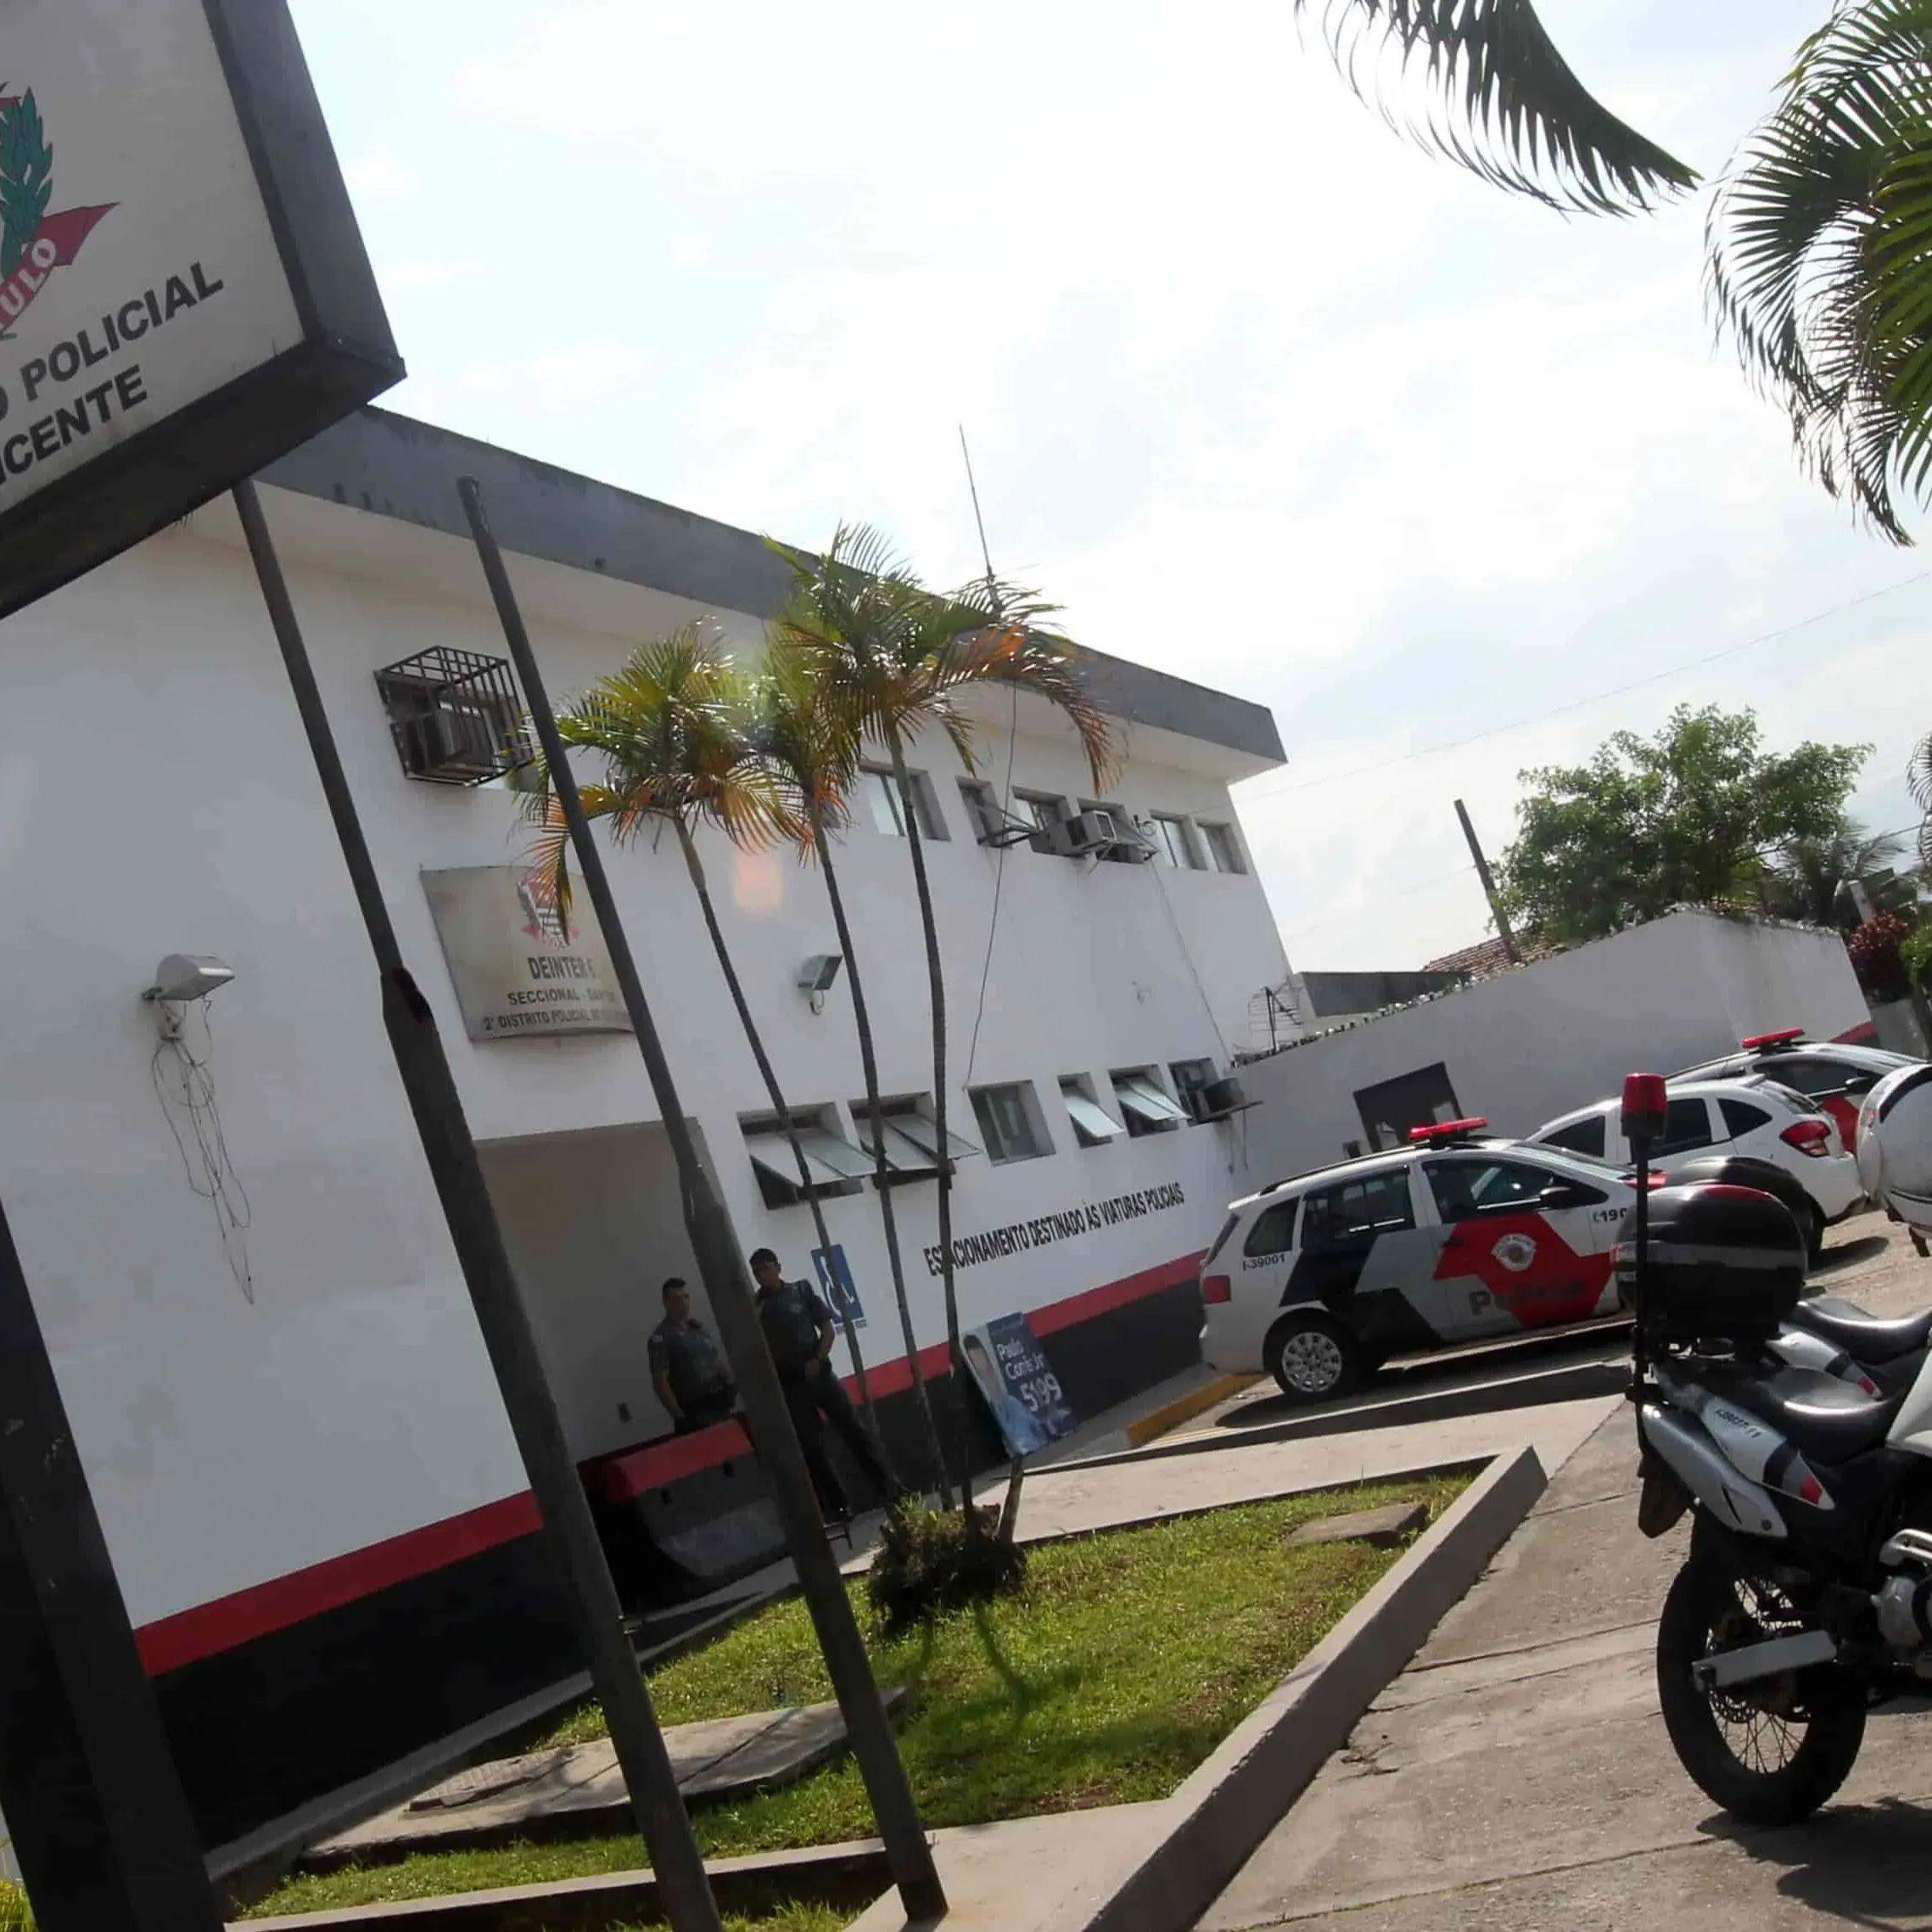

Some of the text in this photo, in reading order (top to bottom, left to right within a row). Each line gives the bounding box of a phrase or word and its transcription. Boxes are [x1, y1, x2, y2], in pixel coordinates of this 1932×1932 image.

[20, 263, 223, 402] POLICIAL
[507, 988, 581, 1005] SECCIONAL
[498, 1011, 549, 1028] DISTRITO
[1027, 1208, 1086, 1247] DESTINADO
[1099, 1192, 1147, 1225] VIATURAS
